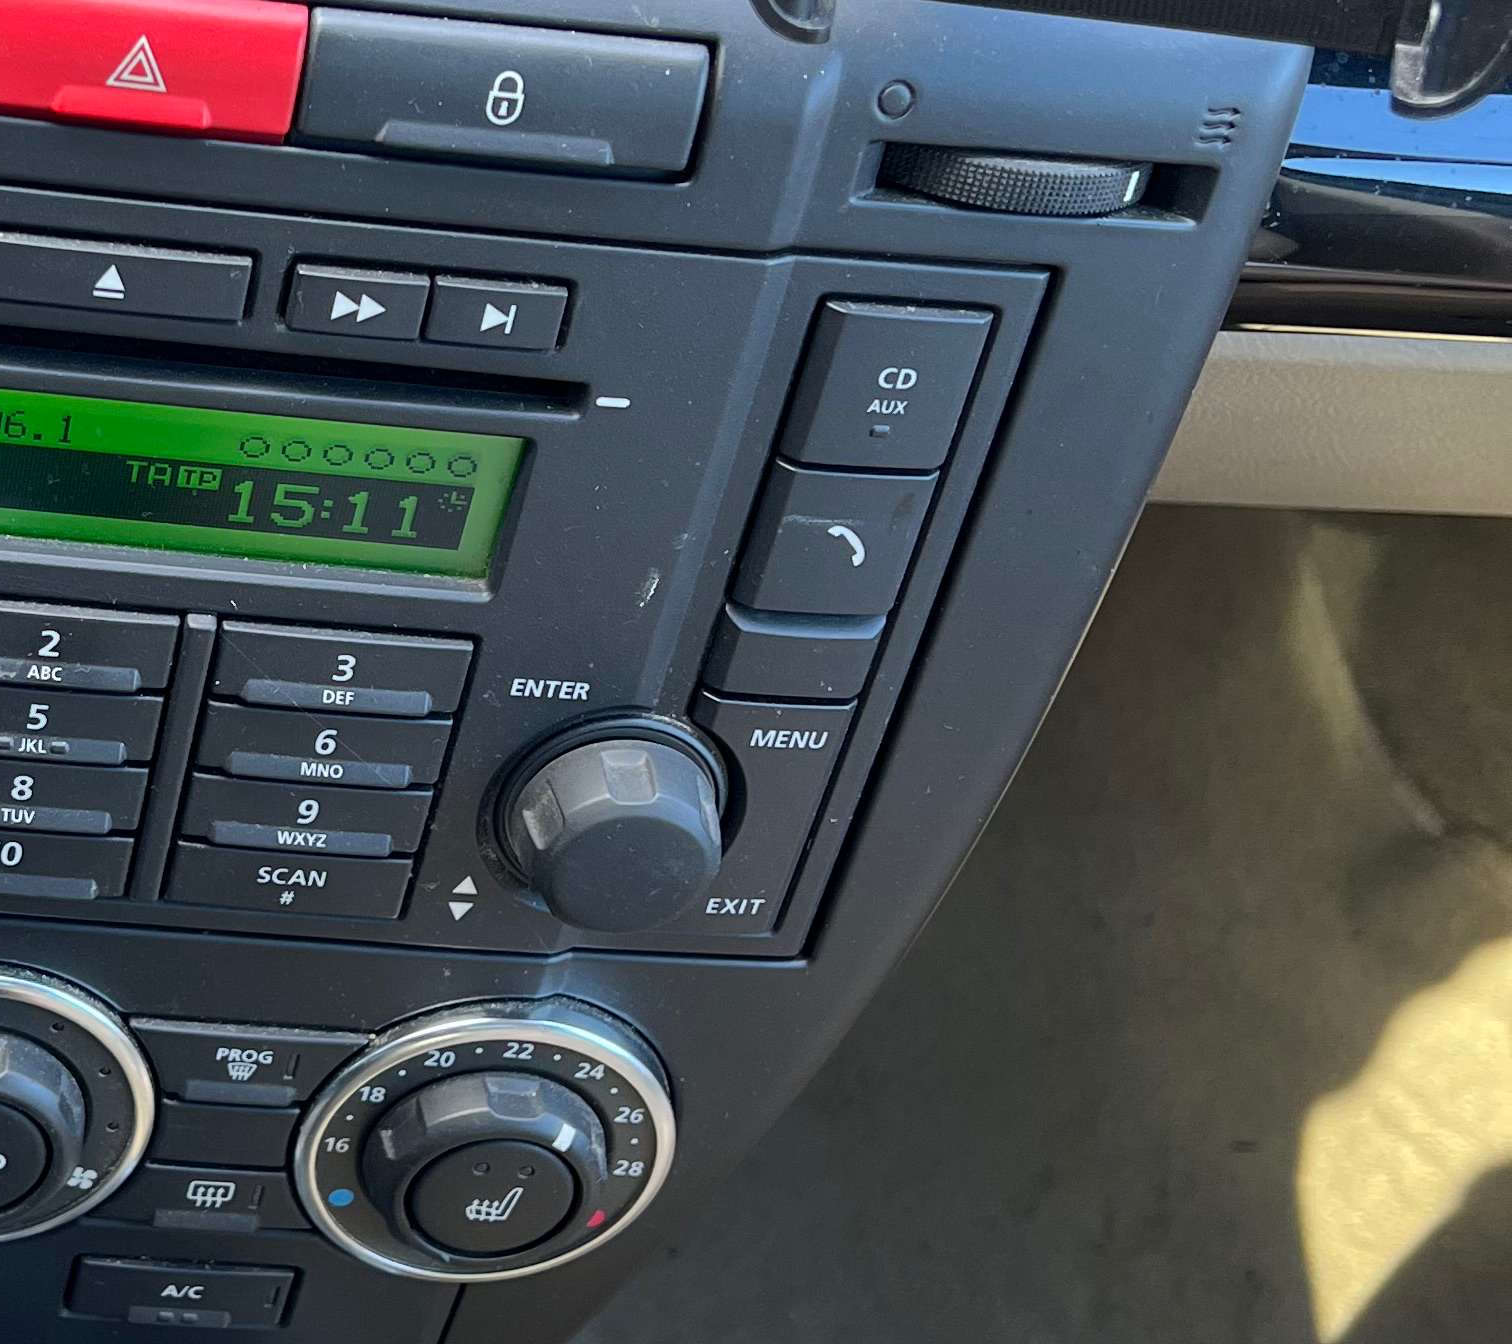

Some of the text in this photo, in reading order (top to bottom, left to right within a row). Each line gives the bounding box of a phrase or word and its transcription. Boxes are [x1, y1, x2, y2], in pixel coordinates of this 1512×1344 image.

[877, 367, 918, 390] CD
[866, 399, 909, 415] AUX
[228, 479, 420, 539] 15:11
[38, 630, 61, 658] 2
[27, 665, 63, 682] ABC
[332, 654, 357, 682] 3
[322, 689, 355, 706] DEF
[510, 678, 591, 701] ENTER
[26, 703, 50, 730] 5
[18, 738, 47, 755] JKL
[314, 729, 338, 756] 6
[749, 728, 829, 750] MENU
[300, 762, 343, 779] MNO
[10, 775, 34, 801] 8
[1, 807, 36, 825] TUV
[297, 799, 320, 825] 9
[277, 830, 328, 849] WXYZ
[256, 866, 328, 887] SCAN
[704, 897, 767, 916] EXIT
[216, 1047, 274, 1065] PROG
[324, 1042, 644, 1178] 16 18 20 22 24 26 28
[161, 1284, 205, 1299] A/C
